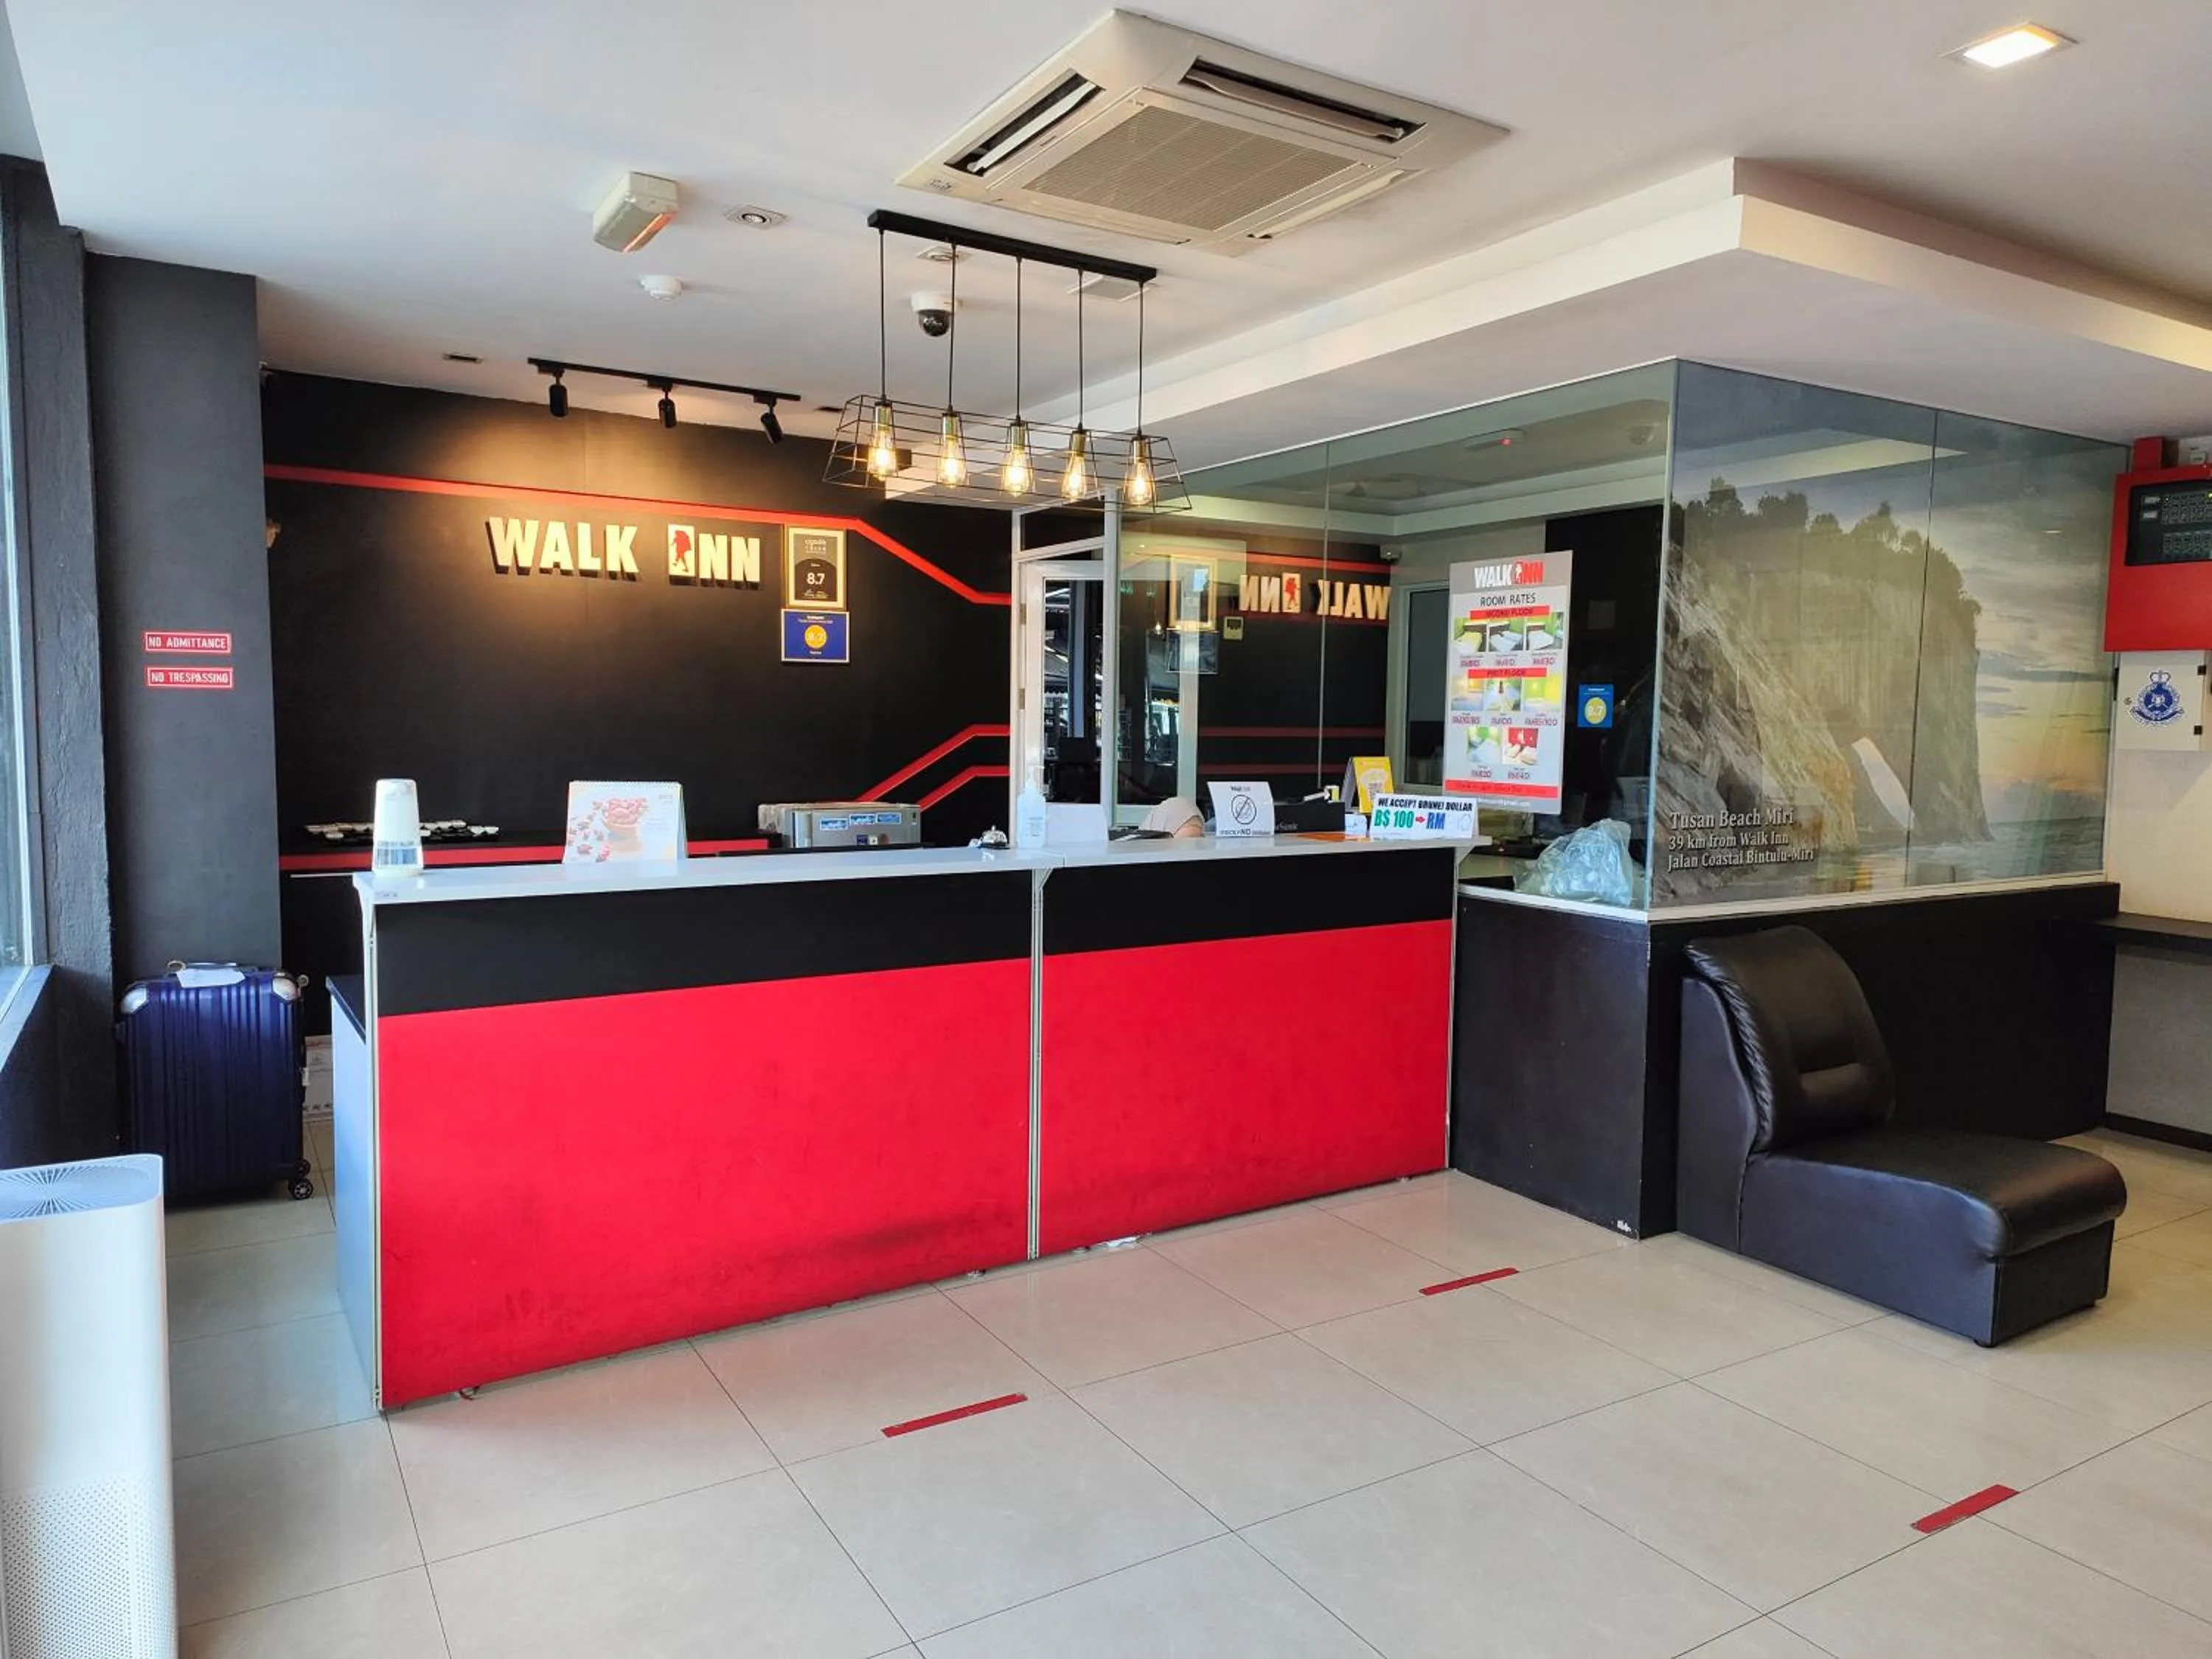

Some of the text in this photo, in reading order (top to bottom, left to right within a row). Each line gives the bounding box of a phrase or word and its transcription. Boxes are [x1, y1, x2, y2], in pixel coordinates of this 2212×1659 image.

[488, 516, 639, 575] WALK
[806, 571, 825, 585] 8.7
[1475, 564, 1512, 588] WALK
[1480, 592, 1536, 607] ROOM RATES
[148, 636, 226, 649] NO ADMITTANCE
[151, 672, 229, 684] NO TRESPASSING
[1378, 798, 1389, 807] WE
[1390, 799, 1417, 808] ACCEPT
[1418, 801, 1444, 810] BRUNEI
[1445, 801, 1473, 812] DOLLAR
[1374, 810, 1447, 830] B$ 100 RM
[1669, 807, 1795, 830] Tusan Beach Miri
[1669, 831, 1789, 850] 39 km from Walk Inn
[1667, 847, 1815, 872] Jalan Coastal Bintulu-Miri
